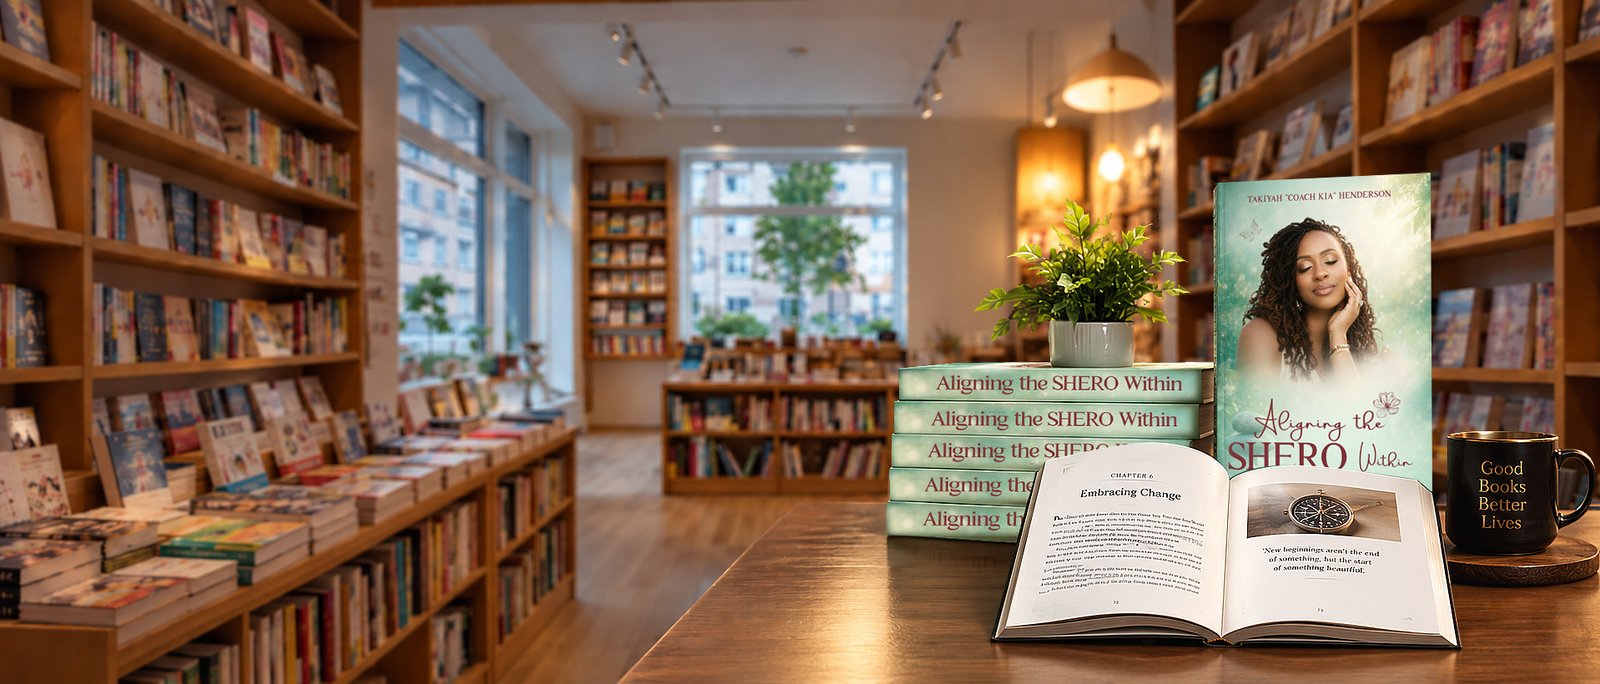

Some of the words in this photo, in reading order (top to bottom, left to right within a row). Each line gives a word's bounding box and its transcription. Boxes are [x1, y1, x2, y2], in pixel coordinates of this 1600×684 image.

[1248, 195, 1283, 203] TAKIYAH
[1285, 193, 1316, 201] "COACH
[1318, 192, 1337, 201] KIA"
[1339, 190, 1392, 199] HENDERSON
[936, 375, 1014, 395] Aligning
[1020, 376, 1048, 391] the
[1052, 375, 1119, 391] SHERO
[1124, 375, 1183, 392] Within
[931, 410, 1009, 431] Aligning
[1014, 411, 1043, 427] the
[1047, 411, 1114, 427] SHERO
[1119, 411, 1178, 428] Within
[1254, 398, 1346, 442] Aligning
[1353, 410, 1386, 431] the
[928, 442, 1006, 462] Aligning
[1010, 443, 1040, 458] the
[1228, 441, 1348, 471] SHERO
[1358, 441, 1414, 472] Within
[1481, 460, 1524, 476] Good
[925, 477, 1003, 497] Aligning
[1008, 477, 1034, 493] the
[1080, 487, 1138, 498] Embracing
[1140, 487, 1182, 501] Change
[1478, 478, 1527, 494] Books
[1478, 496, 1527, 512] Better
[923, 511, 1001, 531] Aligning
[1006, 511, 1025, 527] th
[1481, 514, 1522, 530] Lives
[1283, 545, 1324, 554] beginnings
[1349, 548, 1363, 556] the
[1283, 564, 1325, 572] something
[1339, 556, 1352, 564] the
[1353, 558, 1372, 566] start
